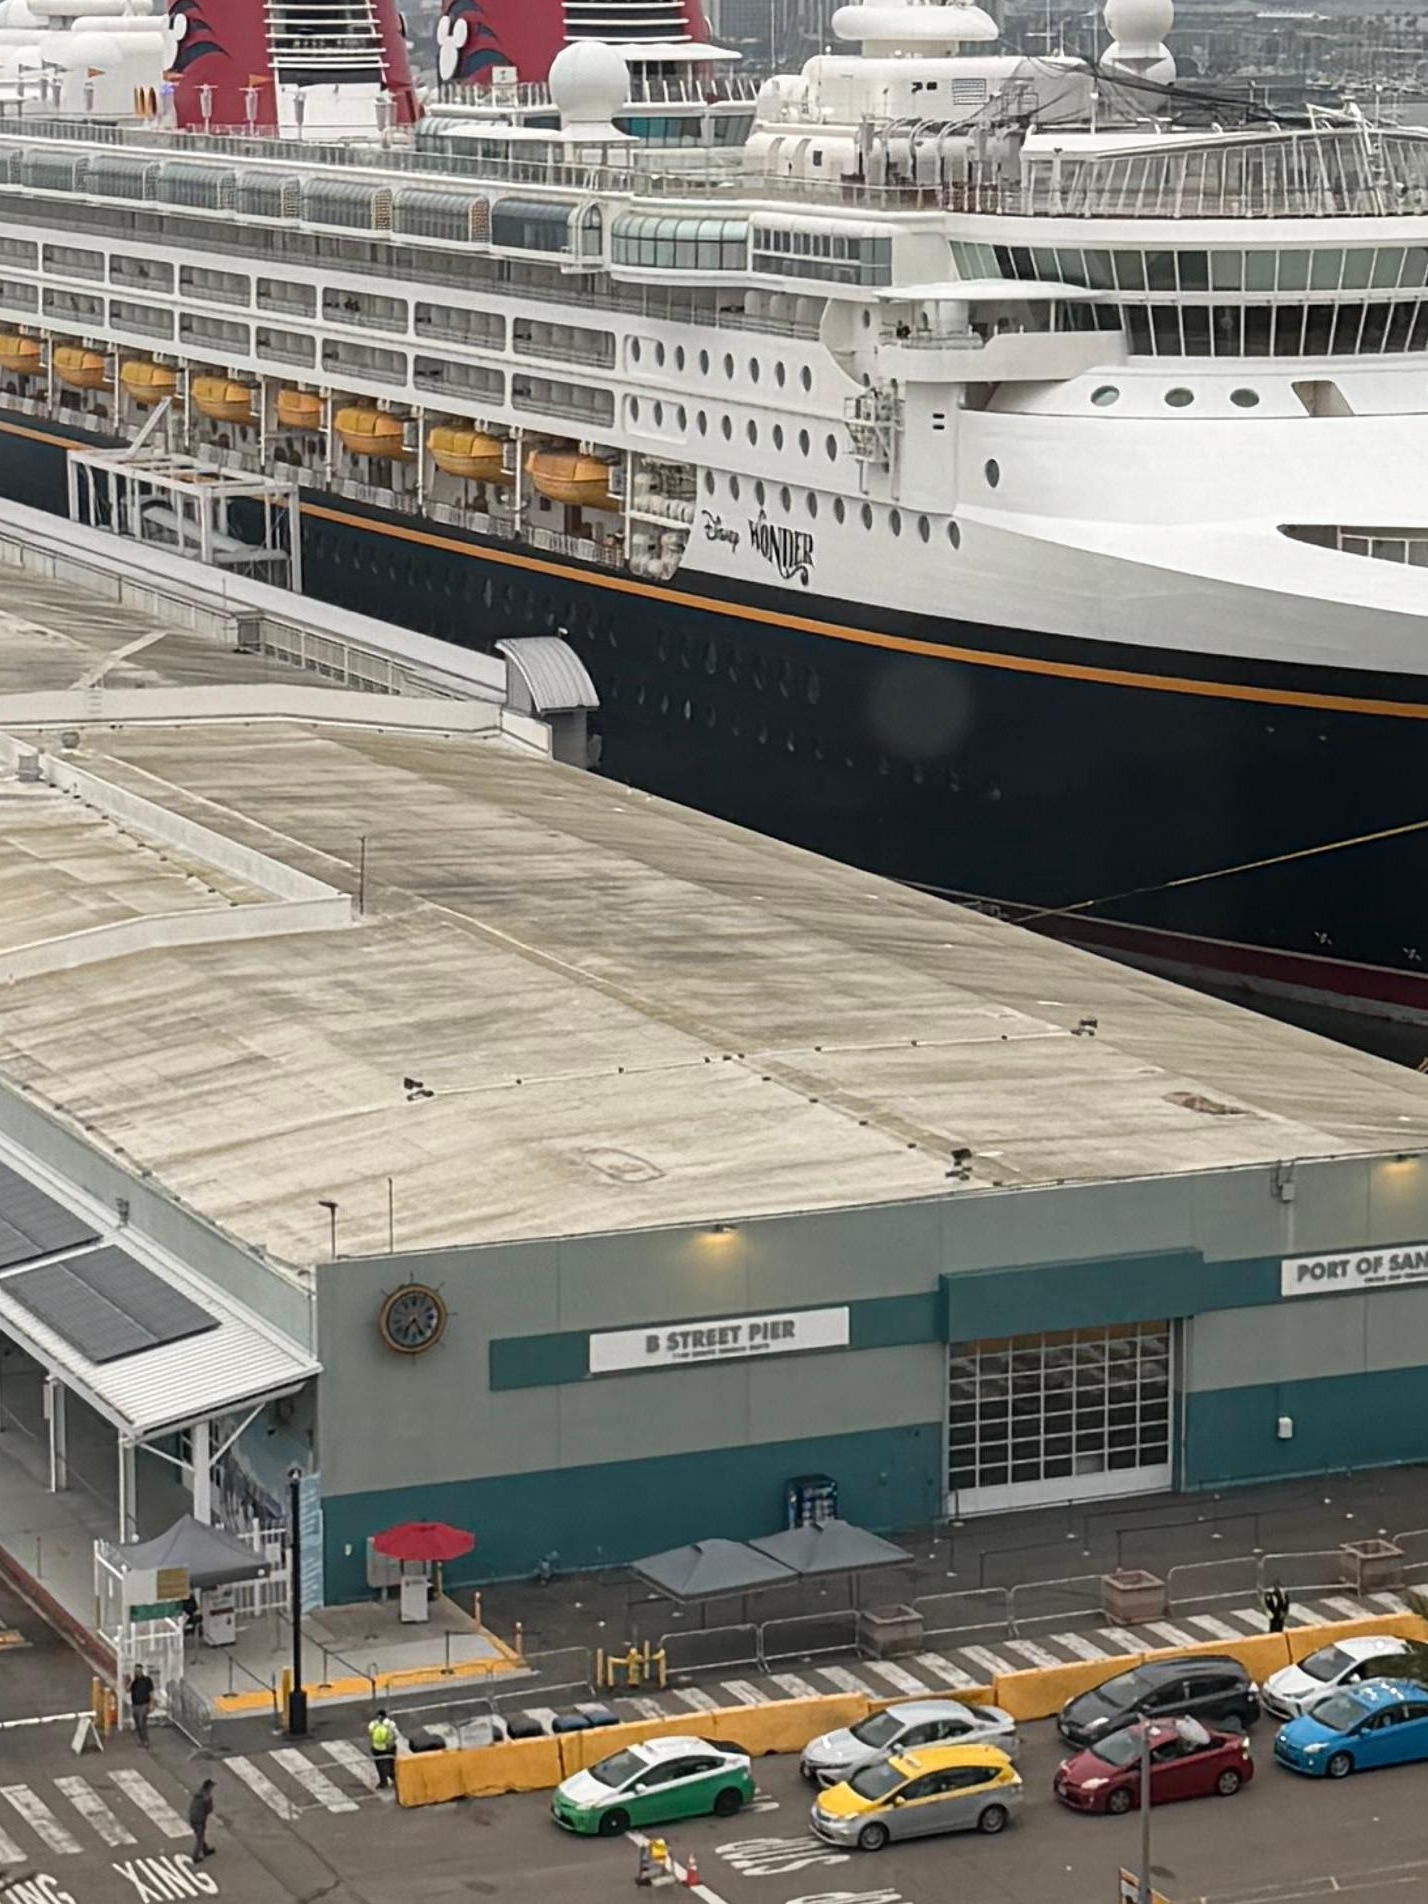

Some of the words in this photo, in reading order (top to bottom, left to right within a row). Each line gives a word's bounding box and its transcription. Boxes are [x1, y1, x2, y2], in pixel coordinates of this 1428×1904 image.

[748, 509, 815, 586] WONDER
[1297, 1259, 1350, 1282] PORT
[1356, 1256, 1384, 1275] OF
[645, 1334, 660, 1354] B
[666, 1325, 742, 1351] STREET
[749, 1319, 795, 1342] PIER
[112, 1854, 219, 1904] XING
